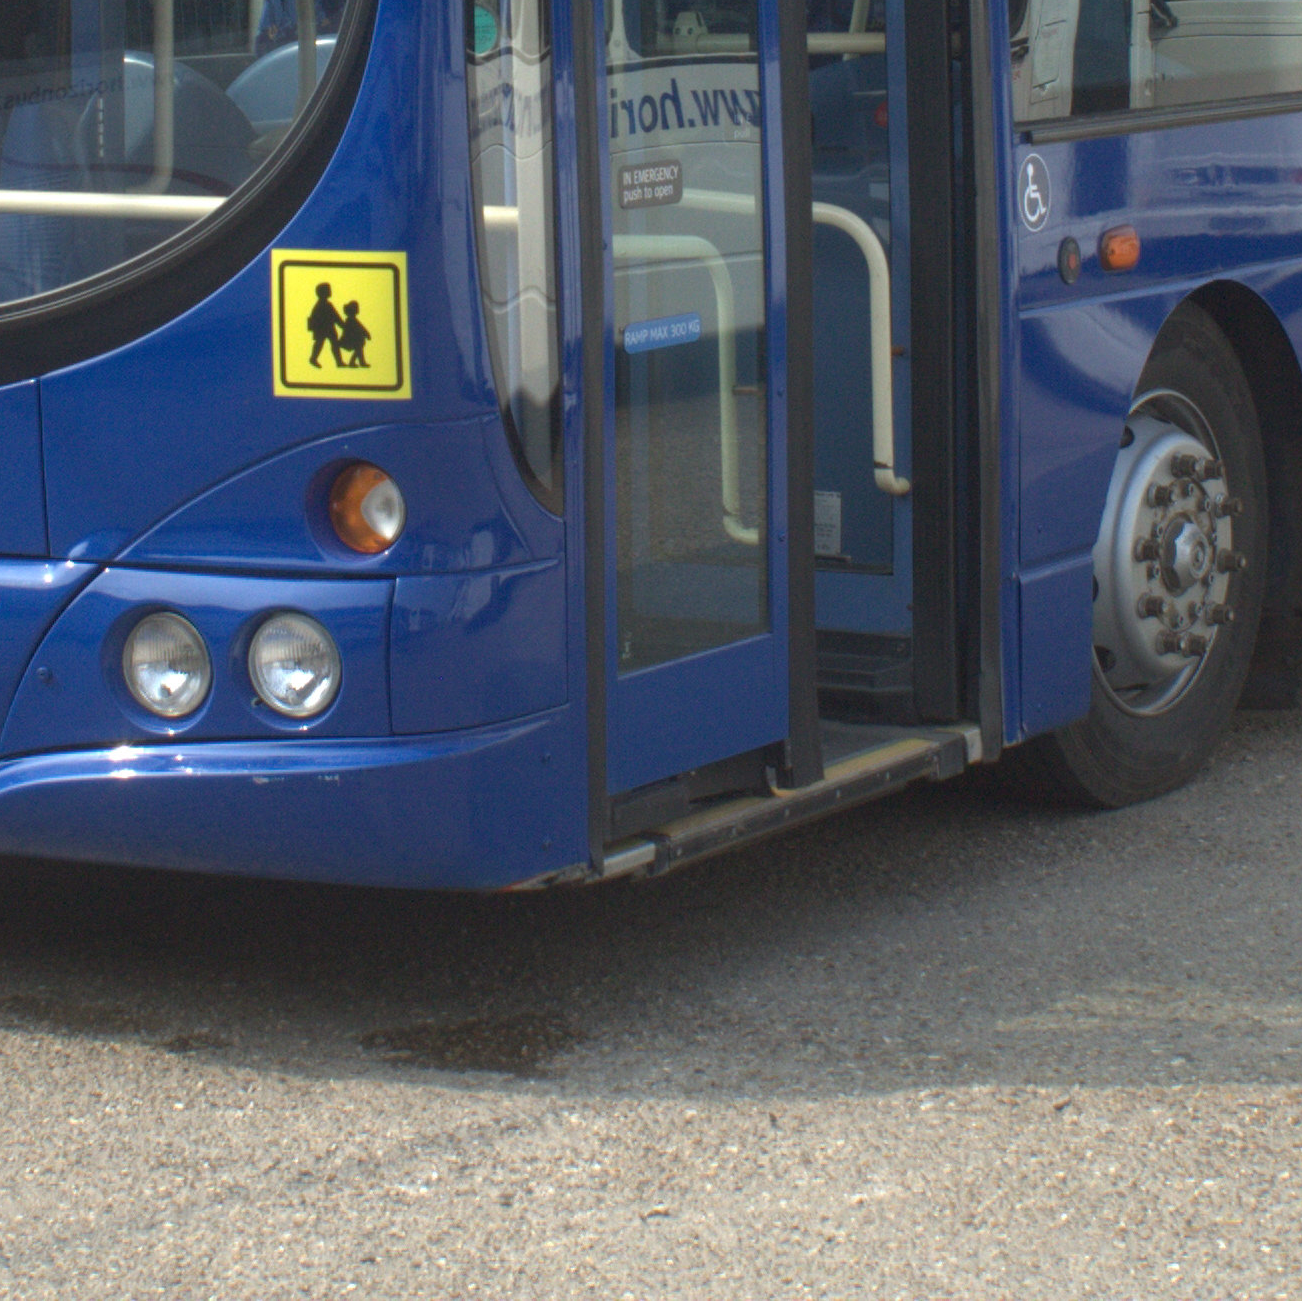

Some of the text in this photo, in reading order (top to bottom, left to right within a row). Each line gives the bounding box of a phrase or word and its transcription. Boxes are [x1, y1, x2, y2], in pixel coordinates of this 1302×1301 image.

[622, 165, 679, 186] IN EMERGENCY
[623, 184, 674, 204] push to open
[625, 319, 700, 346] RAMP MAX 300 KG
